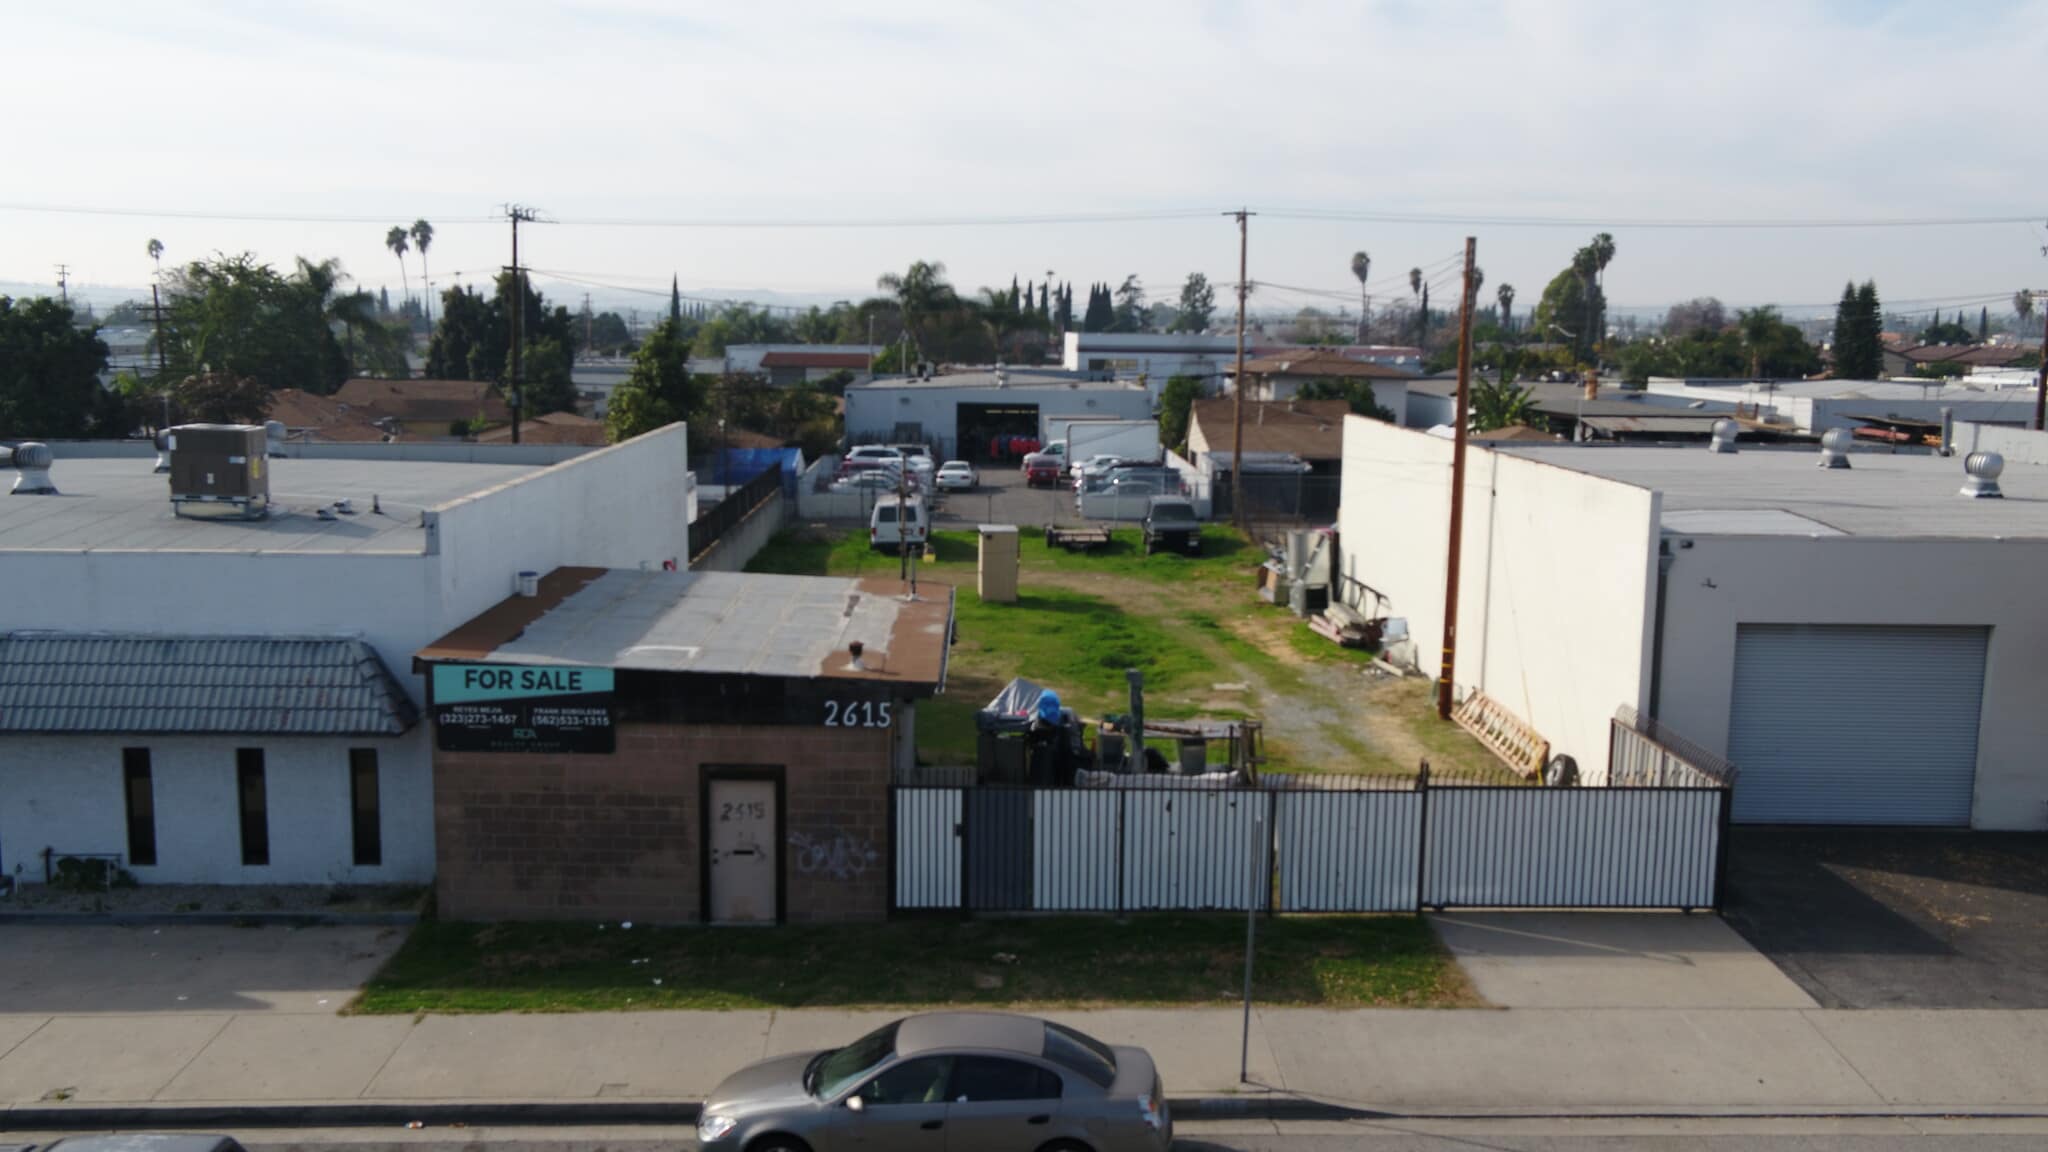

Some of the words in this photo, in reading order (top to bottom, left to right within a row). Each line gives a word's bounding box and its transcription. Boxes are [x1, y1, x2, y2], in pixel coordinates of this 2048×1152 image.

[465, 669, 513, 690] FOR
[521, 670, 582, 691] SALE
[824, 700, 891, 728] 2615
[720, 802, 766, 822] 2615
